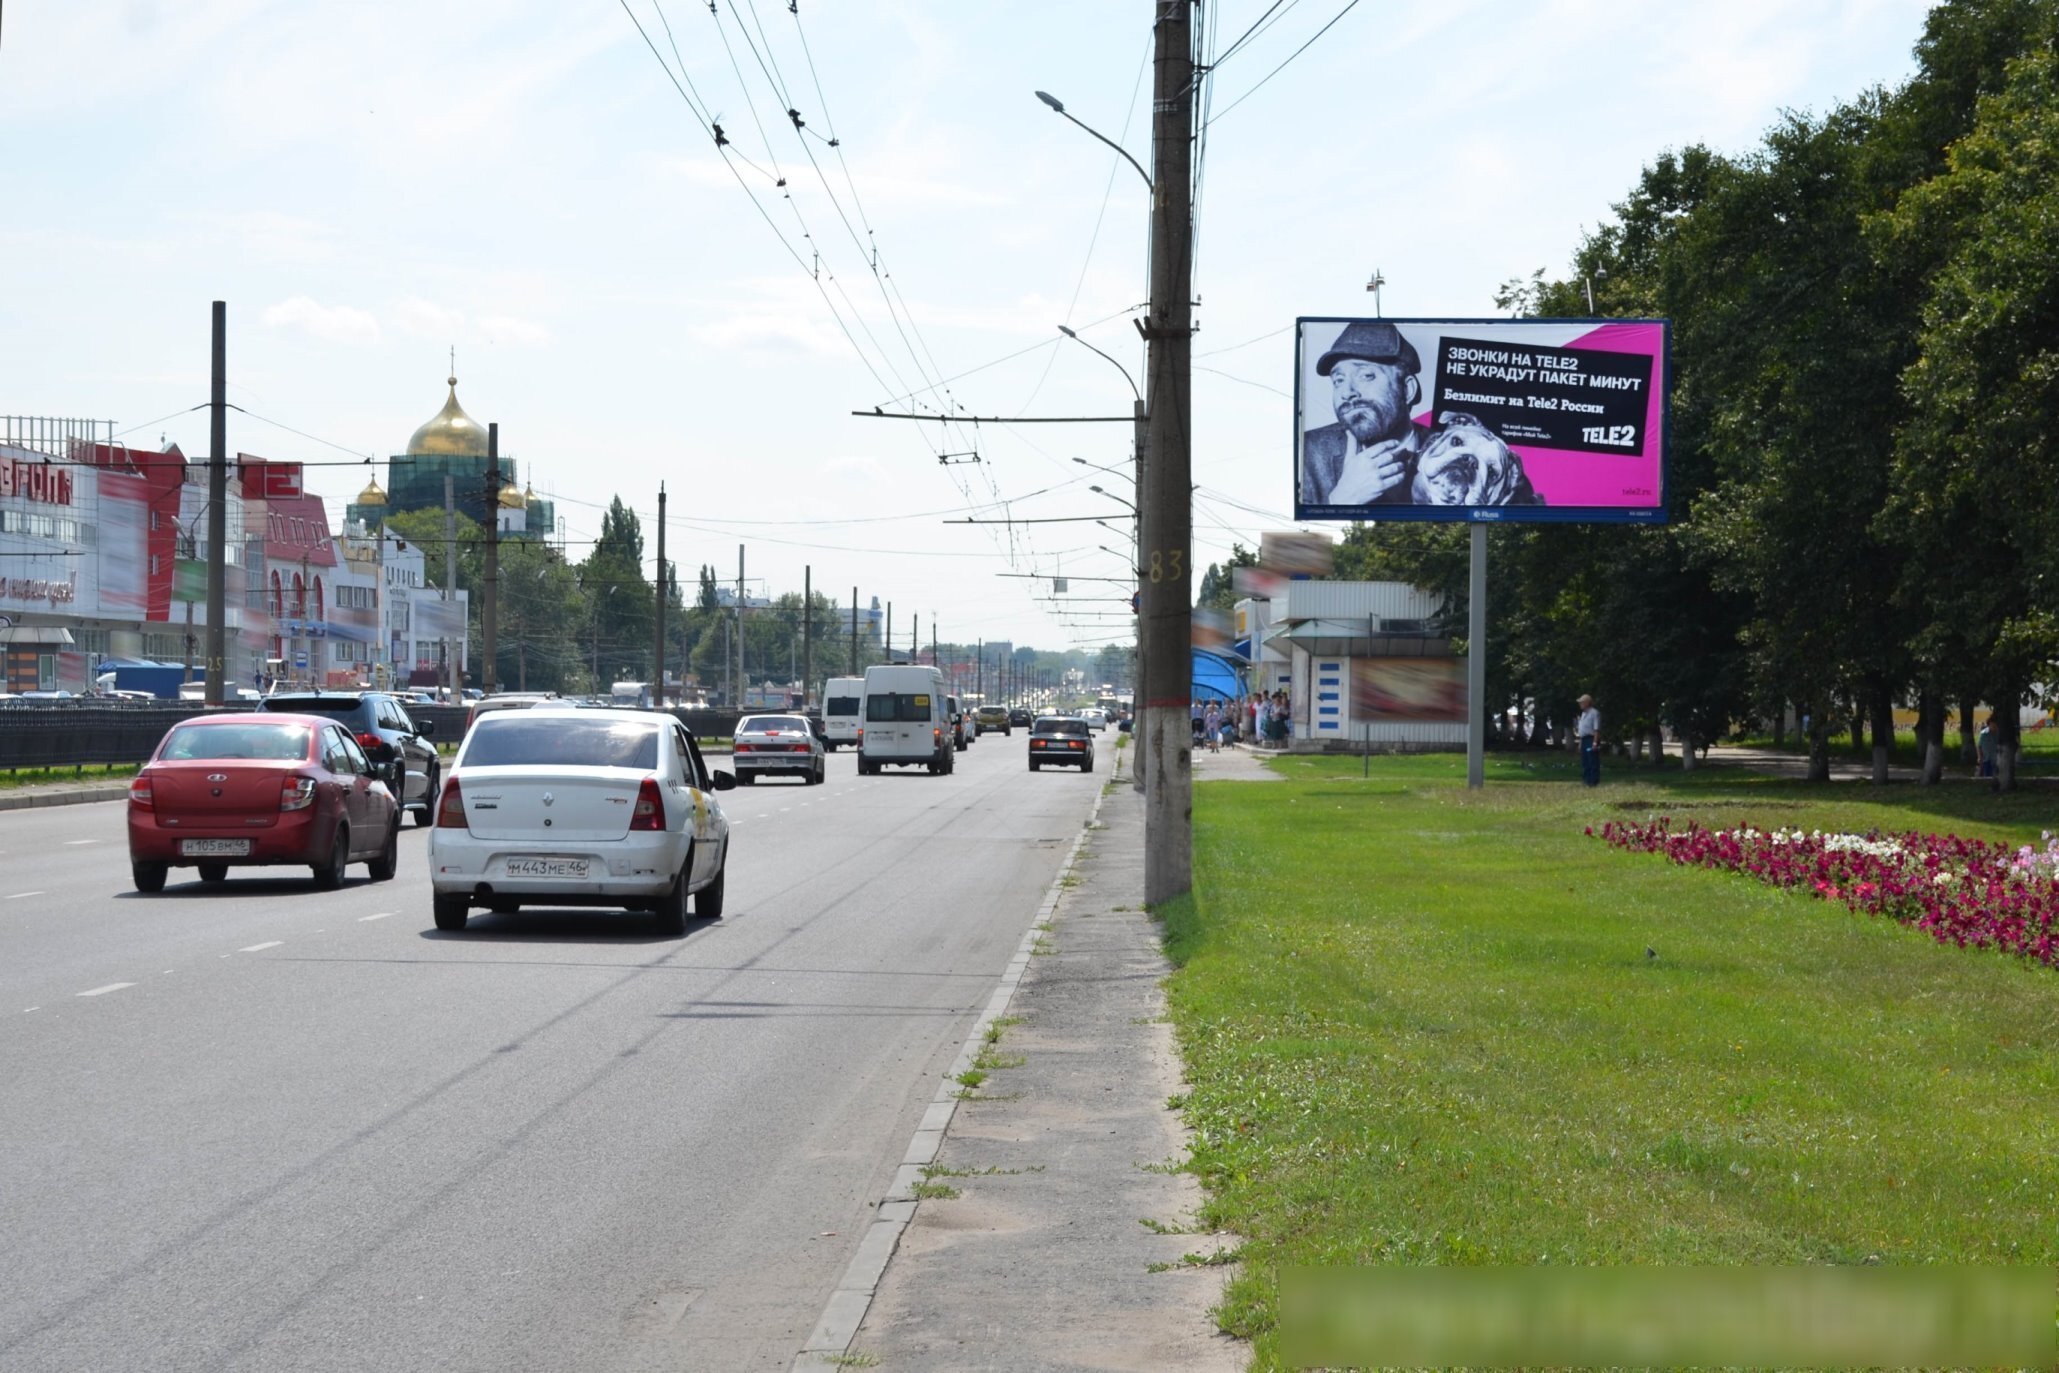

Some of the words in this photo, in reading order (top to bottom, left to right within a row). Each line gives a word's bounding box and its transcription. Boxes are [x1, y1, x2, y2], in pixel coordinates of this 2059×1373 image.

[1448, 347, 1508, 364] ЗВОНКИ
[1512, 353, 1532, 366] НА
[1536, 355, 1578, 370] TELE2
[1446, 362, 1466, 375] НЕ
[1469, 364, 1537, 382] УКРАДУТ
[1539, 370, 1587, 386] ПАКЕТ
[1589, 375, 1641, 391] МИНУТ
[1444, 388, 1506, 405] Безлимит
[1508, 397, 1524, 407] на
[1527, 396, 1558, 410] Tele2
[1560, 399, 1605, 414] России
[1582, 425, 1636, 447] TELE2
[1151, 550, 1183, 584] 83
